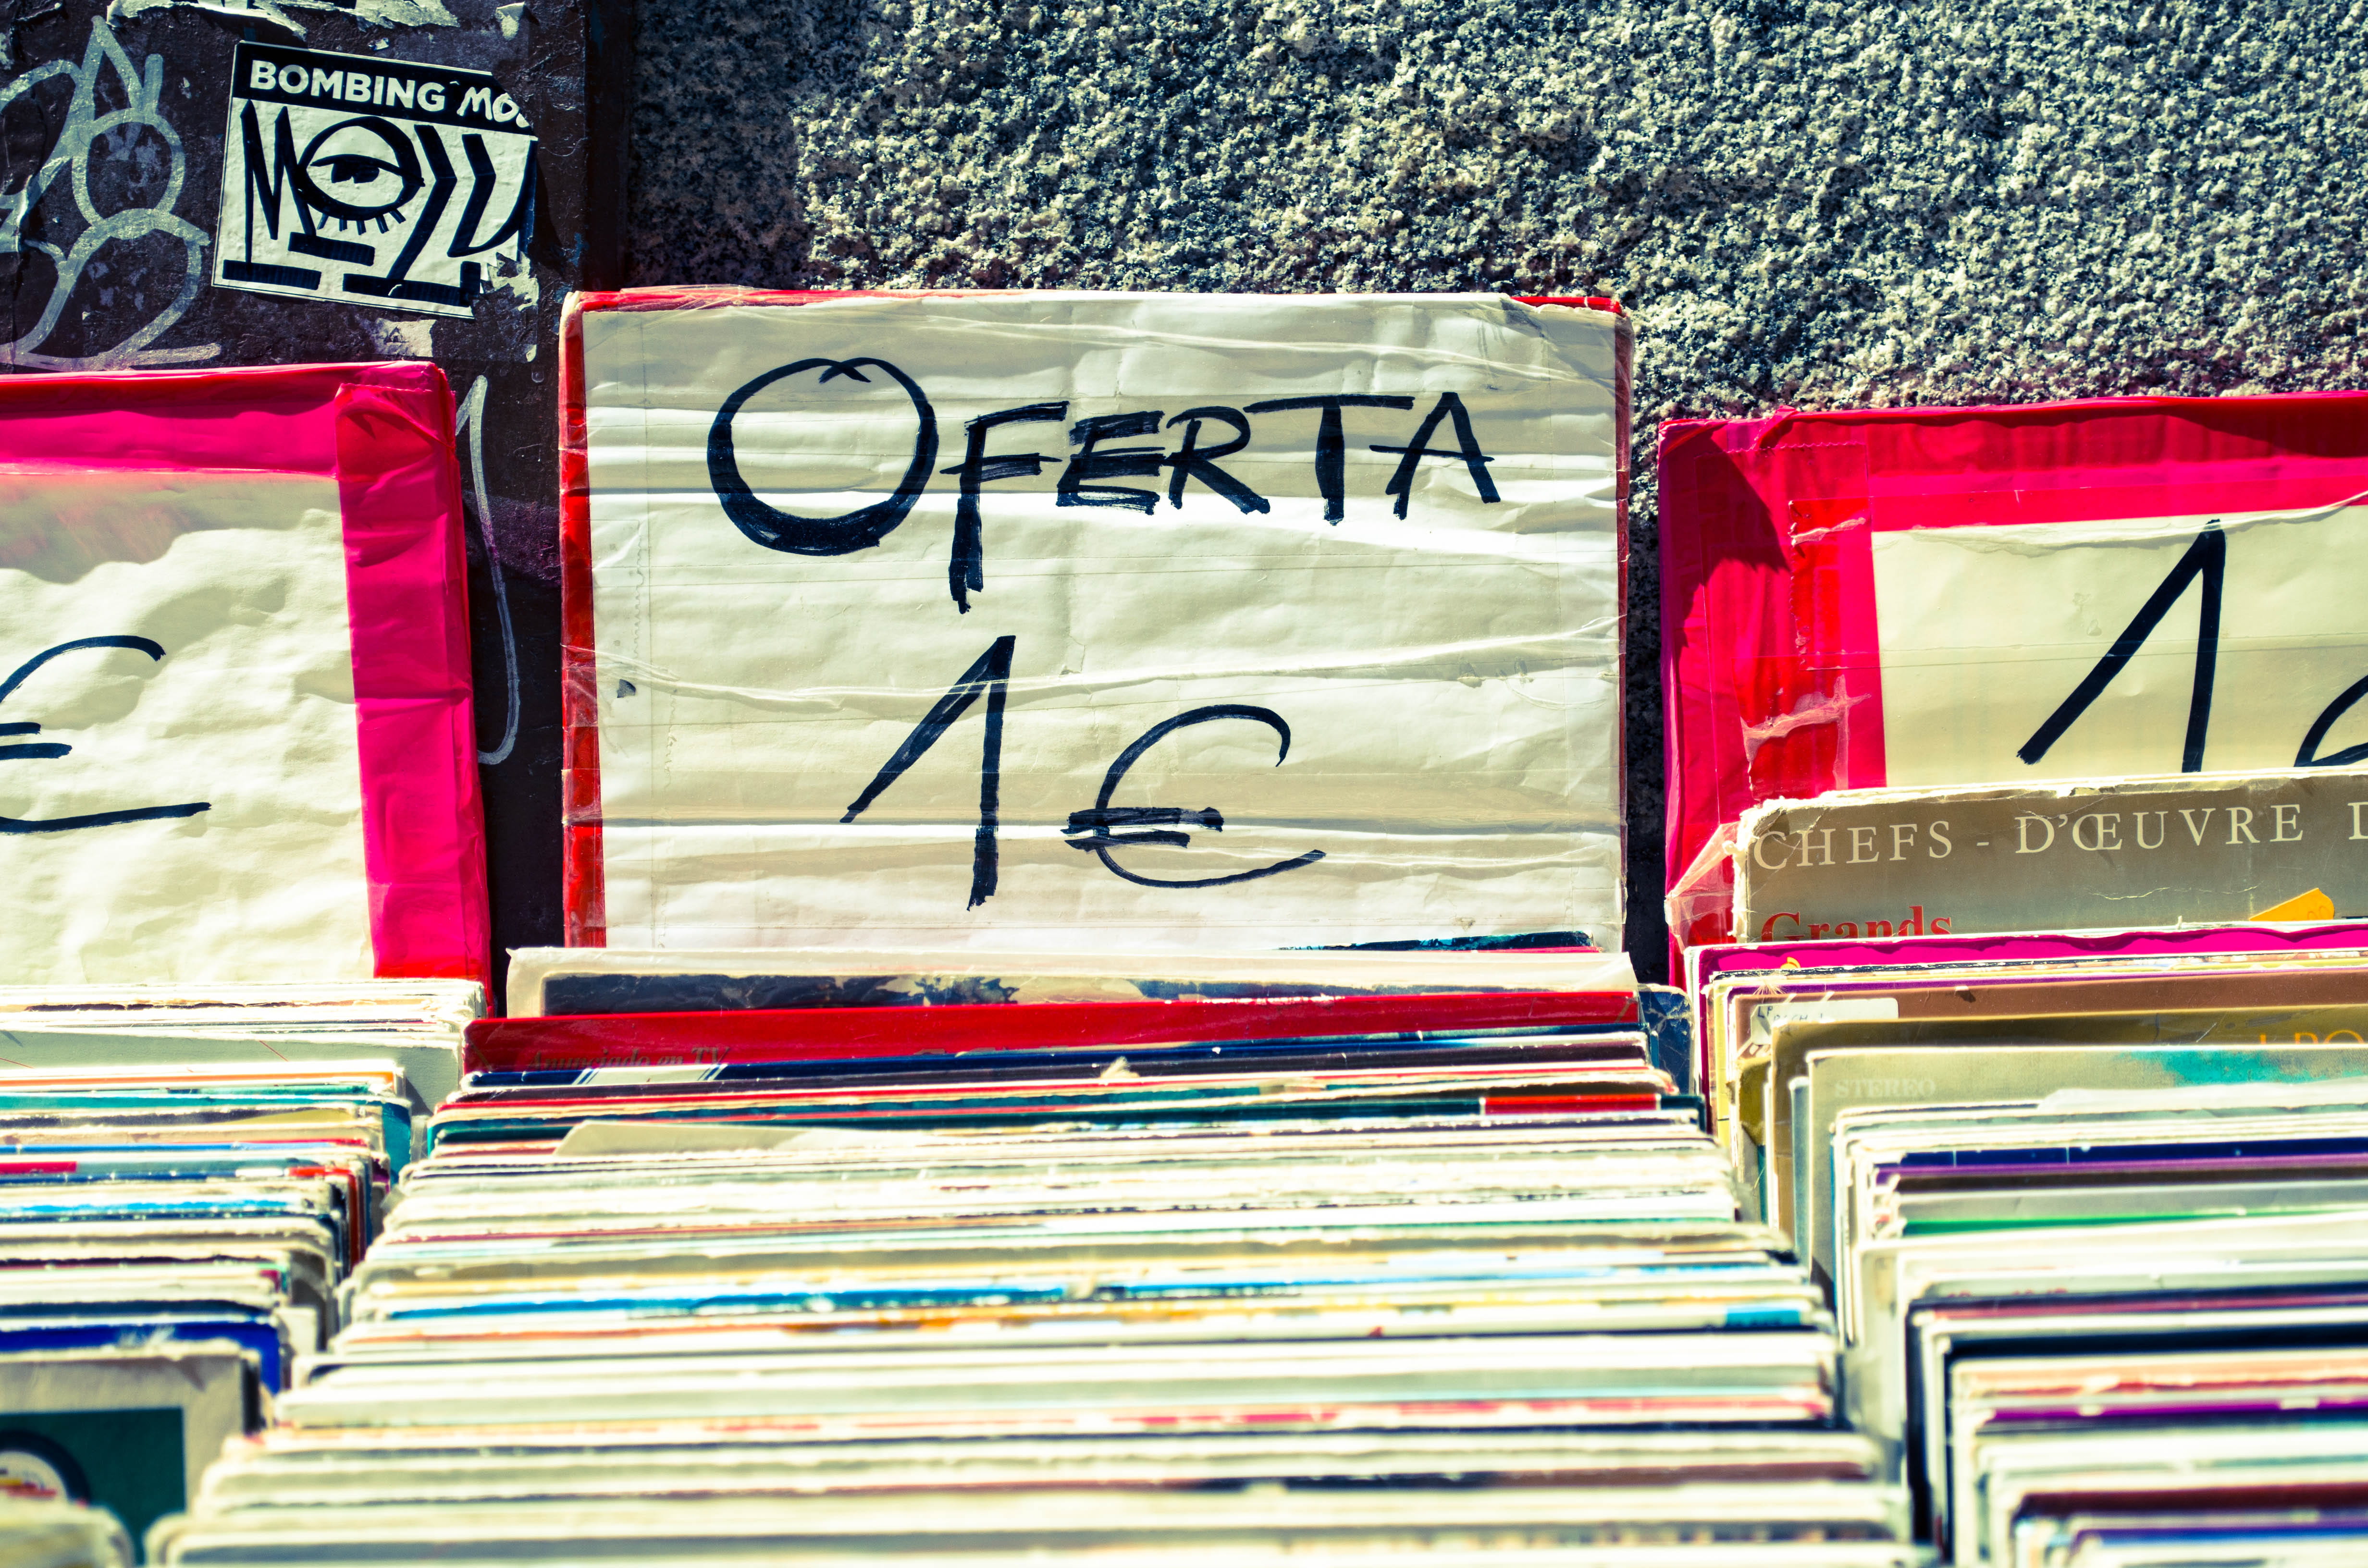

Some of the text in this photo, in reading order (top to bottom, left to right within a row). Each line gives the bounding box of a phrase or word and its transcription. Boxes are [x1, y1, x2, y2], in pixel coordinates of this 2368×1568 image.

[250, 59, 445, 112] BOMBING
[707, 356, 1501, 614] OFERTA
[1753, 821, 1952, 870] CHEFS
[1761, 906, 1952, 942] Grands
[691, 1046, 730, 1064] TV
[1834, 1079, 1936, 1098] STEREO
